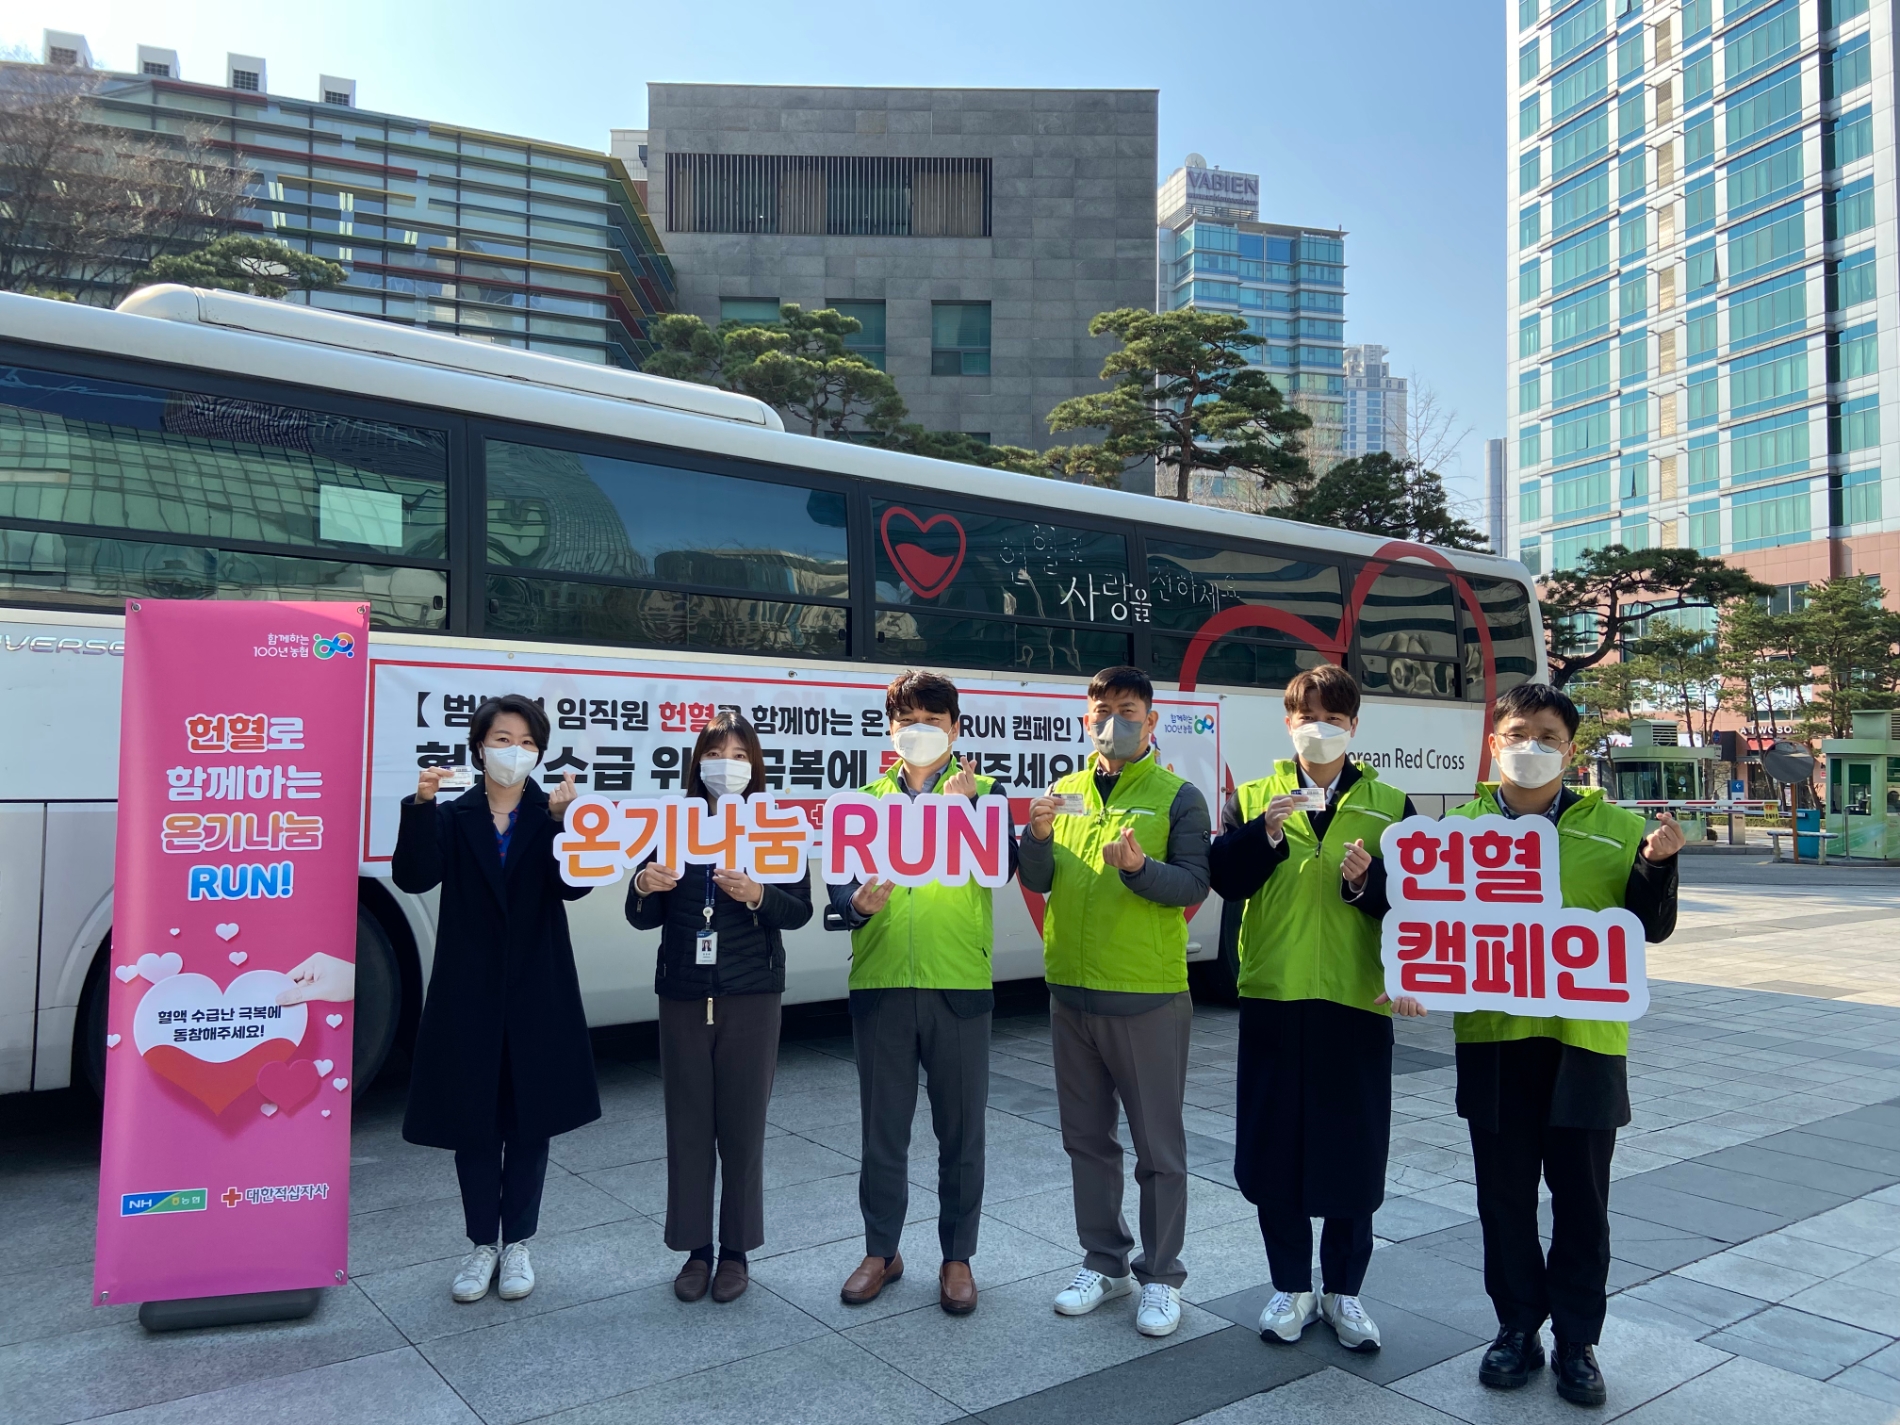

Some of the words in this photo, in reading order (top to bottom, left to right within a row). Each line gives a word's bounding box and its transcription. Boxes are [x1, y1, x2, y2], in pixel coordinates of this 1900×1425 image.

[1187, 170, 1259, 196] VABIEN
[1060, 572, 1152, 622] 사랑을
[0, 635, 125, 656] VERSE
[253, 646, 288, 657] 100년
[290, 646, 309, 657] 농협
[267, 633, 309, 645] 함께하는
[185, 714, 305, 752] 헌혈로
[557, 698, 649, 731] 임직원
[751, 705, 853, 736] 함께하는
[960, 715, 1006, 739] RUN
[1012, 715, 1071, 742] 캠페인
[543, 746, 634, 792] 수급
[1346, 752, 1391, 768] orean
[1395, 748, 1423, 769] Red
[1426, 749, 1465, 770] Cross
[167, 765, 323, 801] 함께하는
[162, 812, 323, 853] 온기나눔
[561, 802, 807, 877] 온기나눔
[831, 804, 999, 876] RUN
[189, 861, 293, 900] RUN!
[1396, 830, 1544, 903] 헌혈
[1397, 920, 1631, 1003] 캠페인
[158, 1009, 187, 1024] 혈액
[191, 1007, 235, 1023] 수급난
[238, 1005, 282, 1021] 극복에
[173, 1024, 265, 1042] 동참해주세요!
[128, 1199, 152, 1209] NH
[181, 1196, 201, 1206] 농협
[246, 1183, 328, 1204] 대한적십자사
